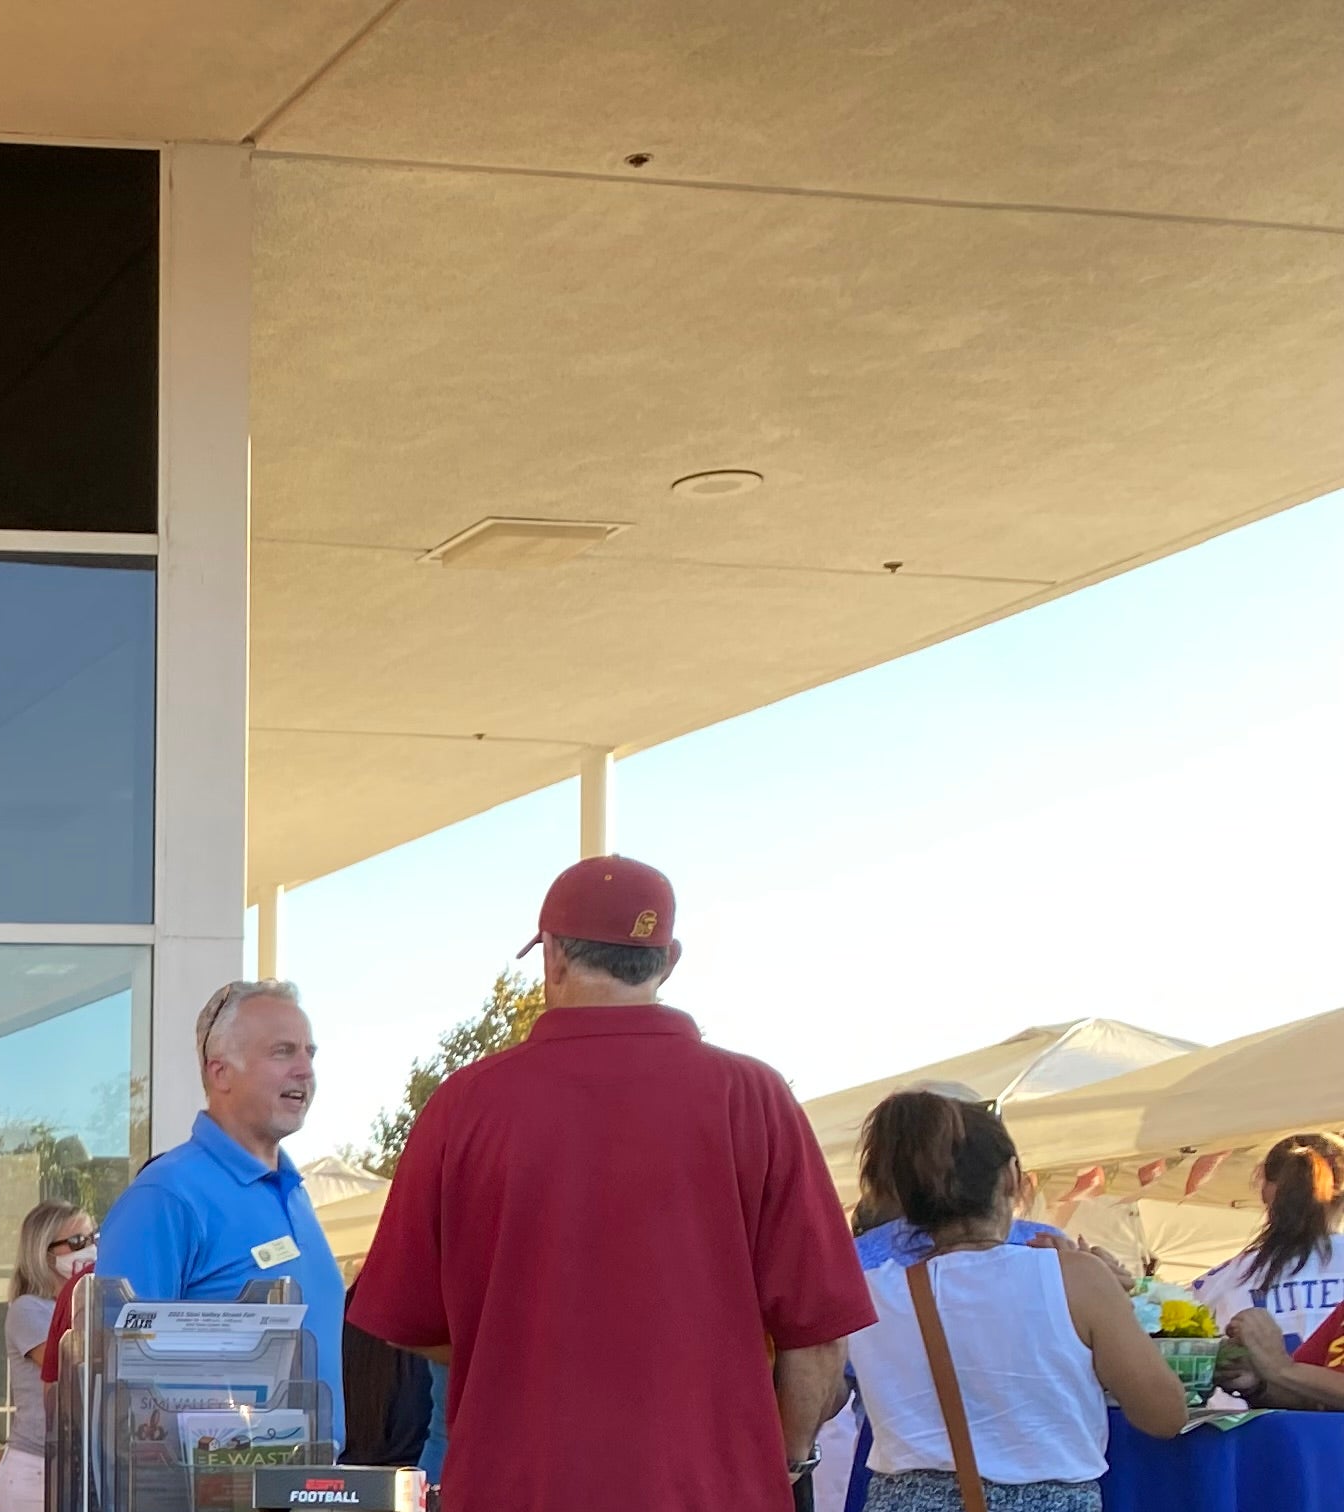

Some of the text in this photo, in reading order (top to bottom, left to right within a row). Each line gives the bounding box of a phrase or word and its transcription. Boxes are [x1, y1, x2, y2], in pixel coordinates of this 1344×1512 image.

[123, 1319, 154, 1330] FAIR
[305, 1479, 346, 1490] ESPN
[289, 1490, 360, 1504] FOOTBALL
